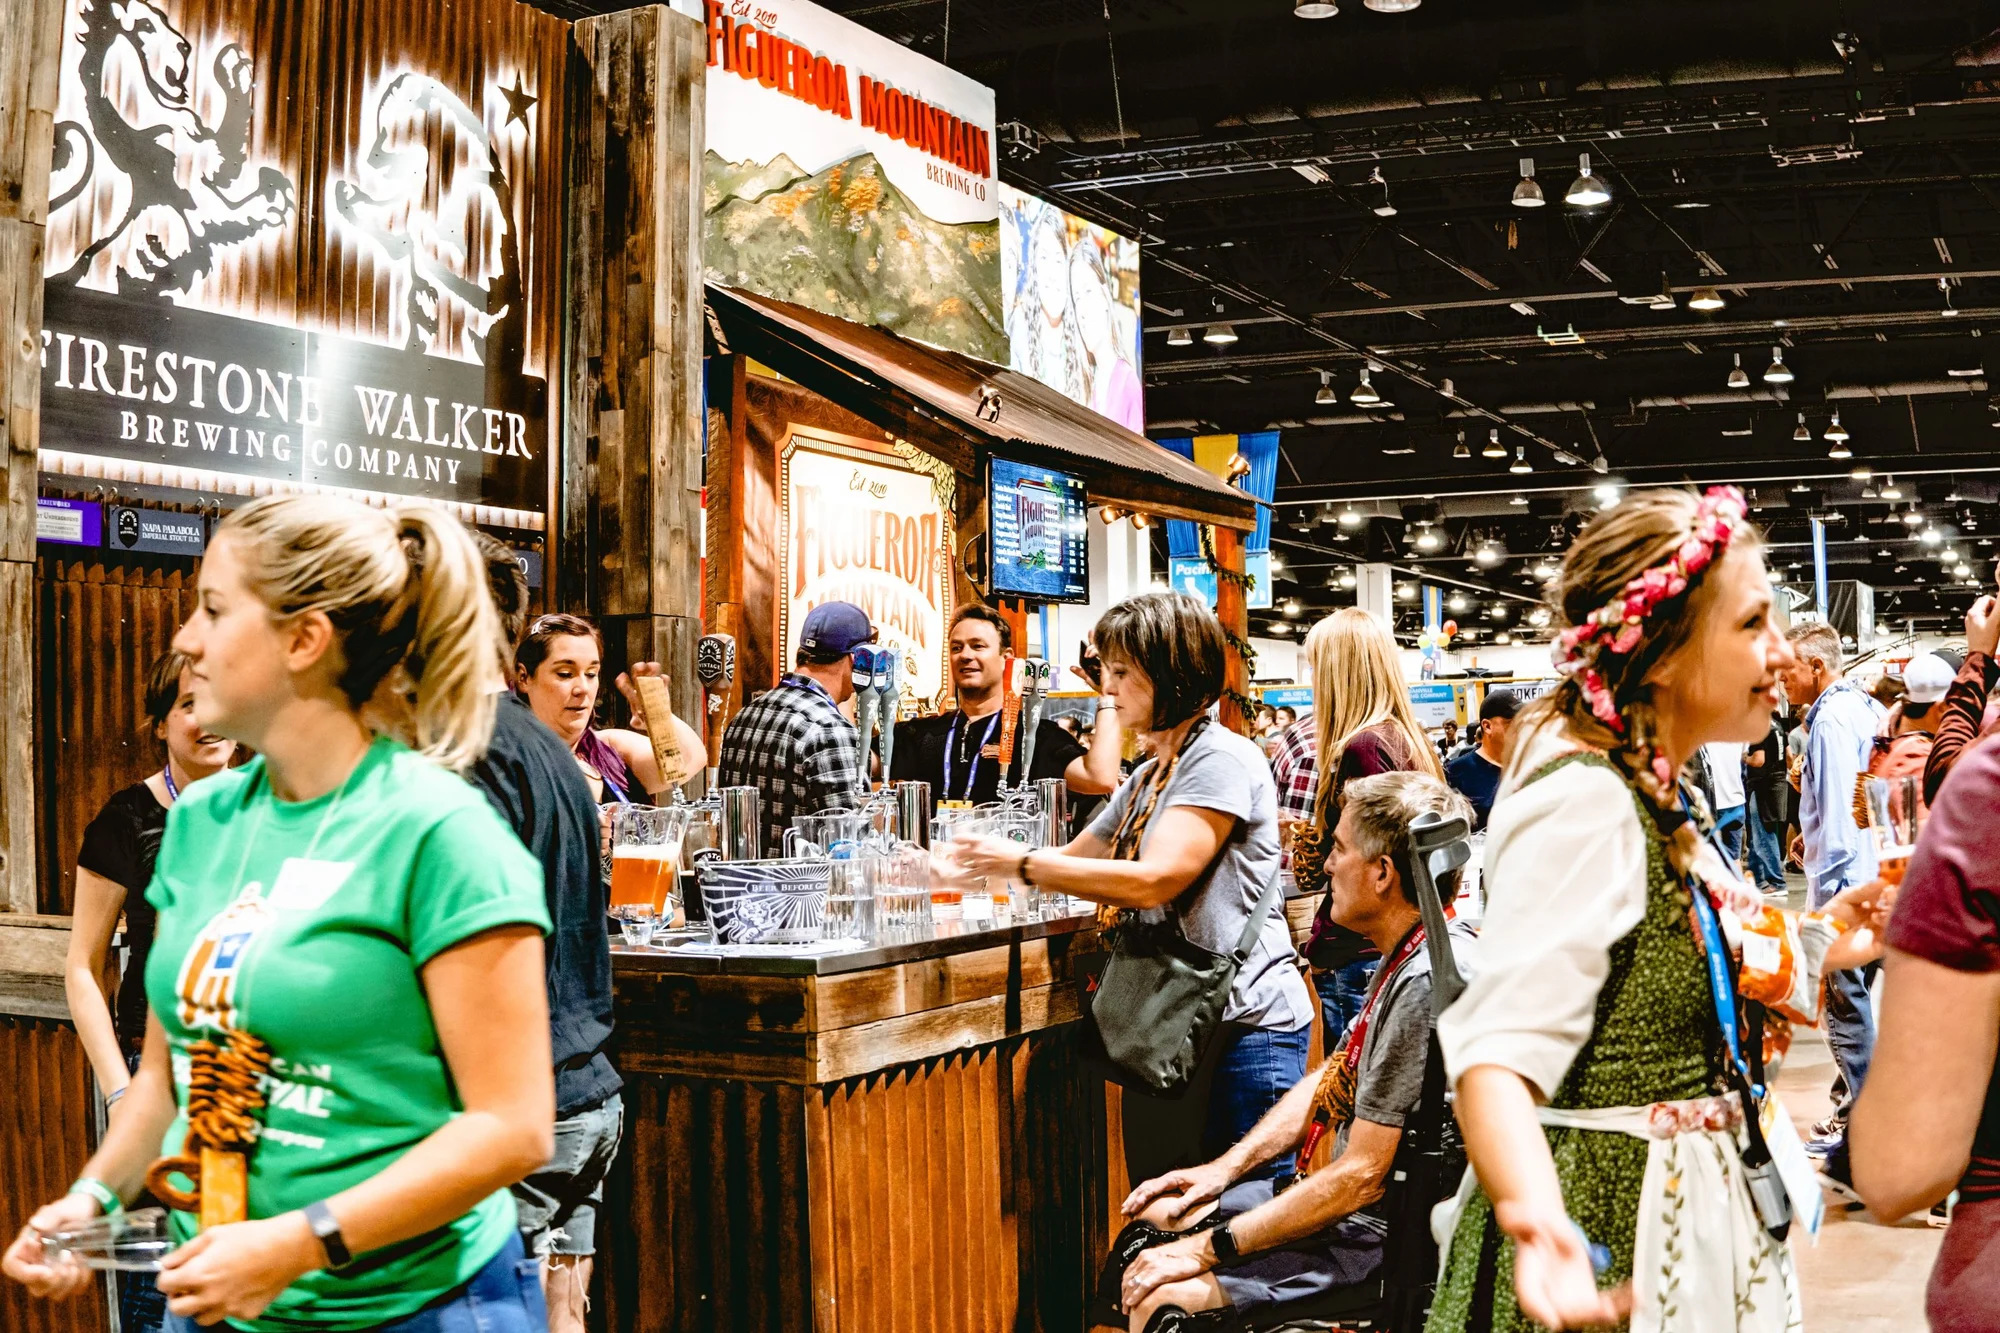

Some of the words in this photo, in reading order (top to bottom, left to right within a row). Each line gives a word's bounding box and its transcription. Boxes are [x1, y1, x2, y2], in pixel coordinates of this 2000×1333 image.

[731, 0, 752, 17] Est
[754, 8, 778, 28] 2010
[703, 0, 852, 121] FIGUEROA
[858, 75, 991, 180] MOUNTAIN
[926, 162, 970, 196] BREWING
[974, 182, 986, 202] CO
[353, 385, 533, 460] WALKER
[120, 410, 290, 462] BREWING
[311, 439, 462, 485] COMPANY
[849, 469, 864, 492] Est
[868, 481, 888, 499] 2010
[142, 523, 161, 532] NAPA
[162, 525, 200, 536] PARABOLA
[142, 532, 168, 541] IMPERIAL
[169, 534, 187, 542] STOUT
[794, 484, 943, 612] FIGUEROA
[699, 639, 722, 660] FIRESTONE
[699, 662, 721, 670] VINTAGE
[781, 882, 814, 892] BEFORE
